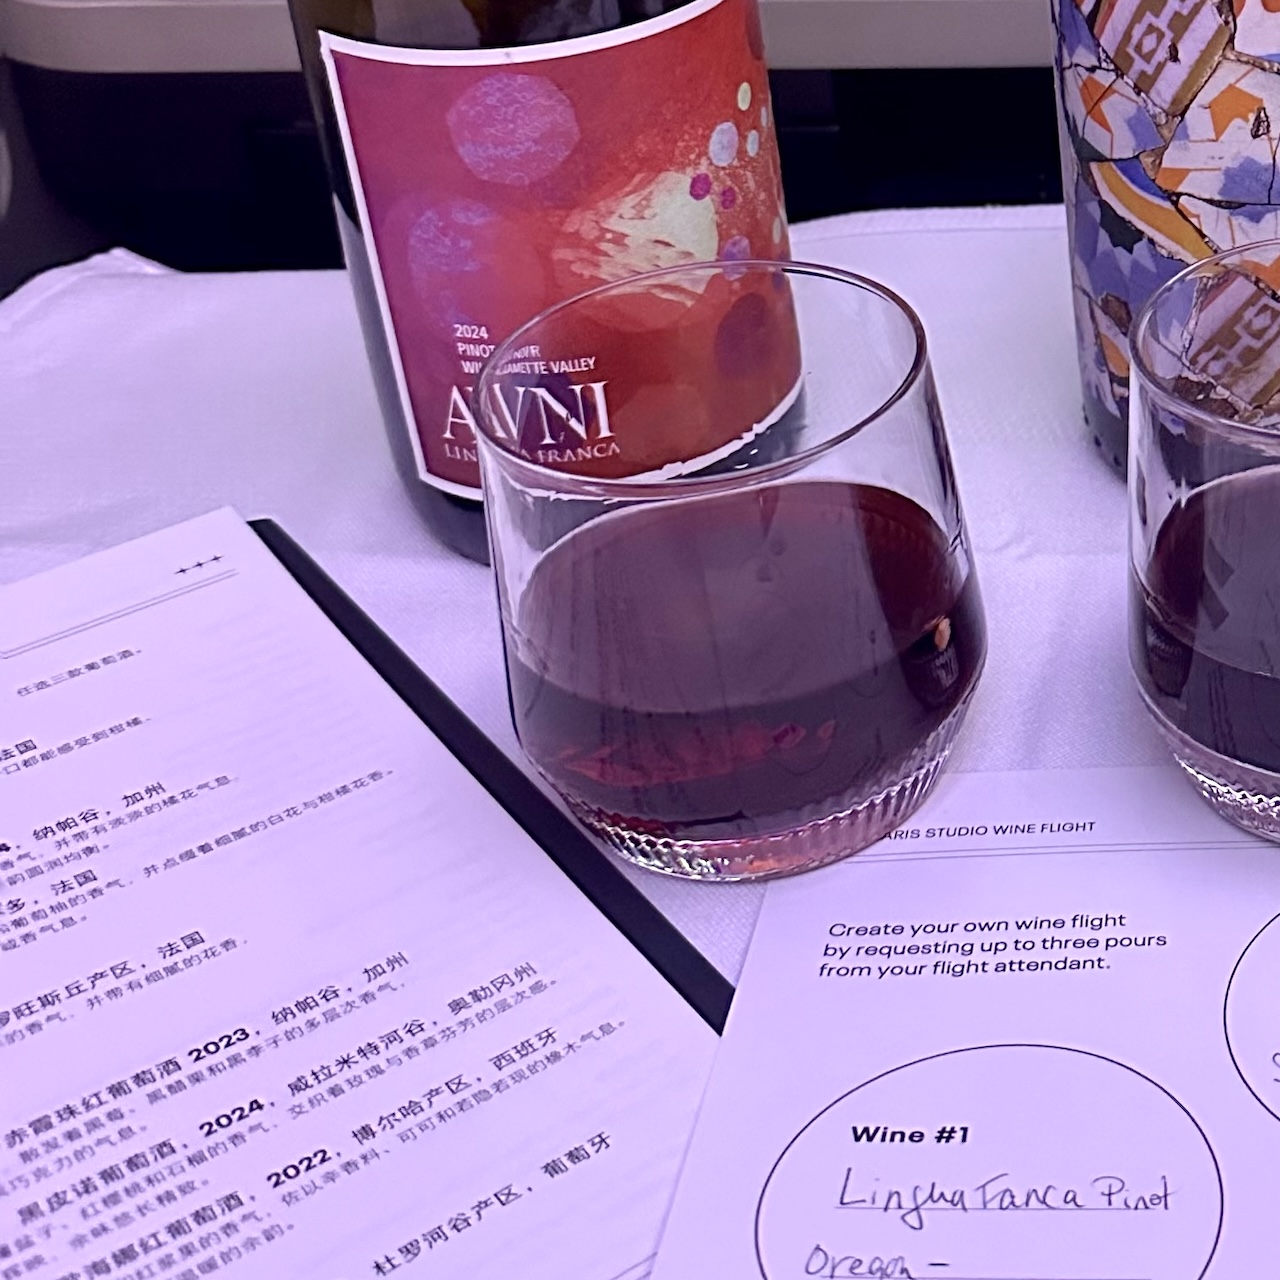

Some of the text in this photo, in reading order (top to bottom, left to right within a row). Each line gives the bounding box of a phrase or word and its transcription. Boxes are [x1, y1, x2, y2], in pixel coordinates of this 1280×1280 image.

[454, 323, 489, 339] 2024
[457, 342, 496, 358] PINOT
[550, 357, 596, 374] VALLEY
[445, 442, 621, 464] LINA FRANCA
[925, 825, 988, 838] STUDIO
[993, 824, 1036, 836] WINE
[1040, 821, 1096, 833] FLIGHT
[828, 914, 1127, 938] Create your own wine flight
[823, 934, 1167, 959] by requesting up to three pours
[819, 956, 1111, 980] from your flight attendant.
[851, 1126, 970, 1144] Wine #1
[1091, 1175, 1175, 1211] Pinot
